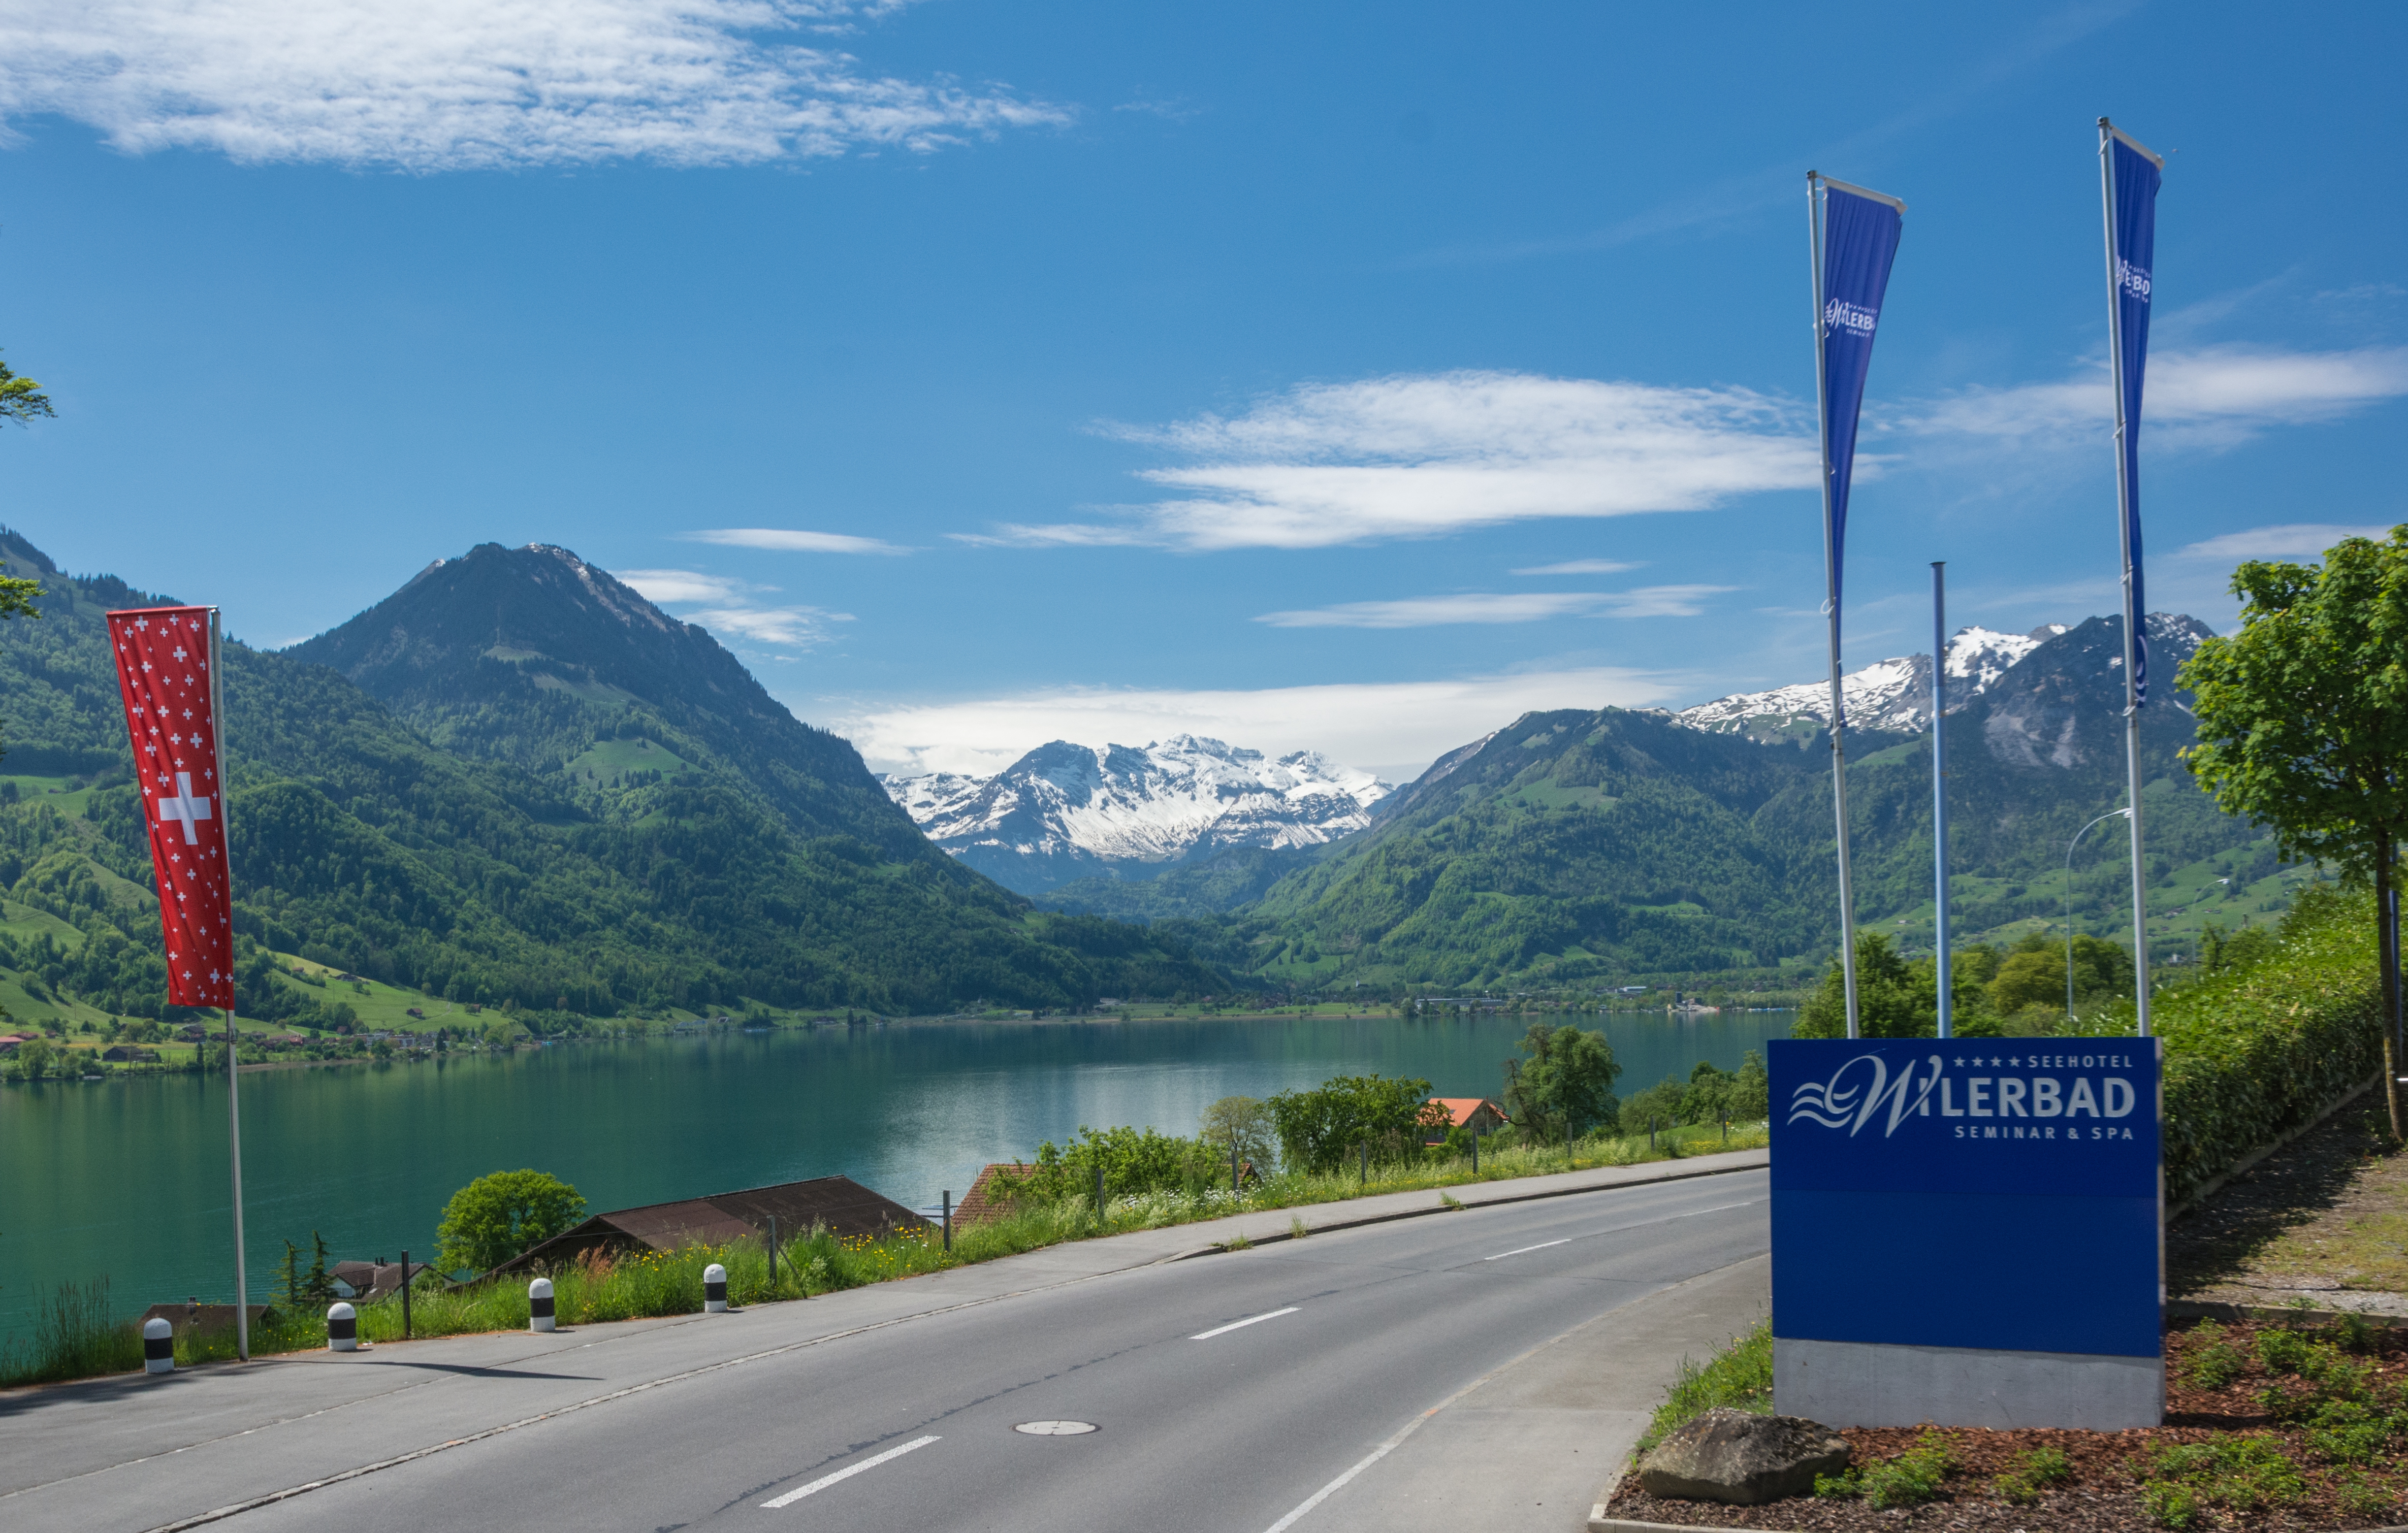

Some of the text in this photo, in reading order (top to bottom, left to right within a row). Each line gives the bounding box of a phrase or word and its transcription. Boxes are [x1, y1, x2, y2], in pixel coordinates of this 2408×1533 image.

[1827, 298, 1876, 330] WILERB
[2029, 1055, 2132, 1068] SEEHOTEL
[1825, 1055, 2135, 1138] WILERBAD
[1955, 1126, 2133, 1139] SEMINAR & SPA
